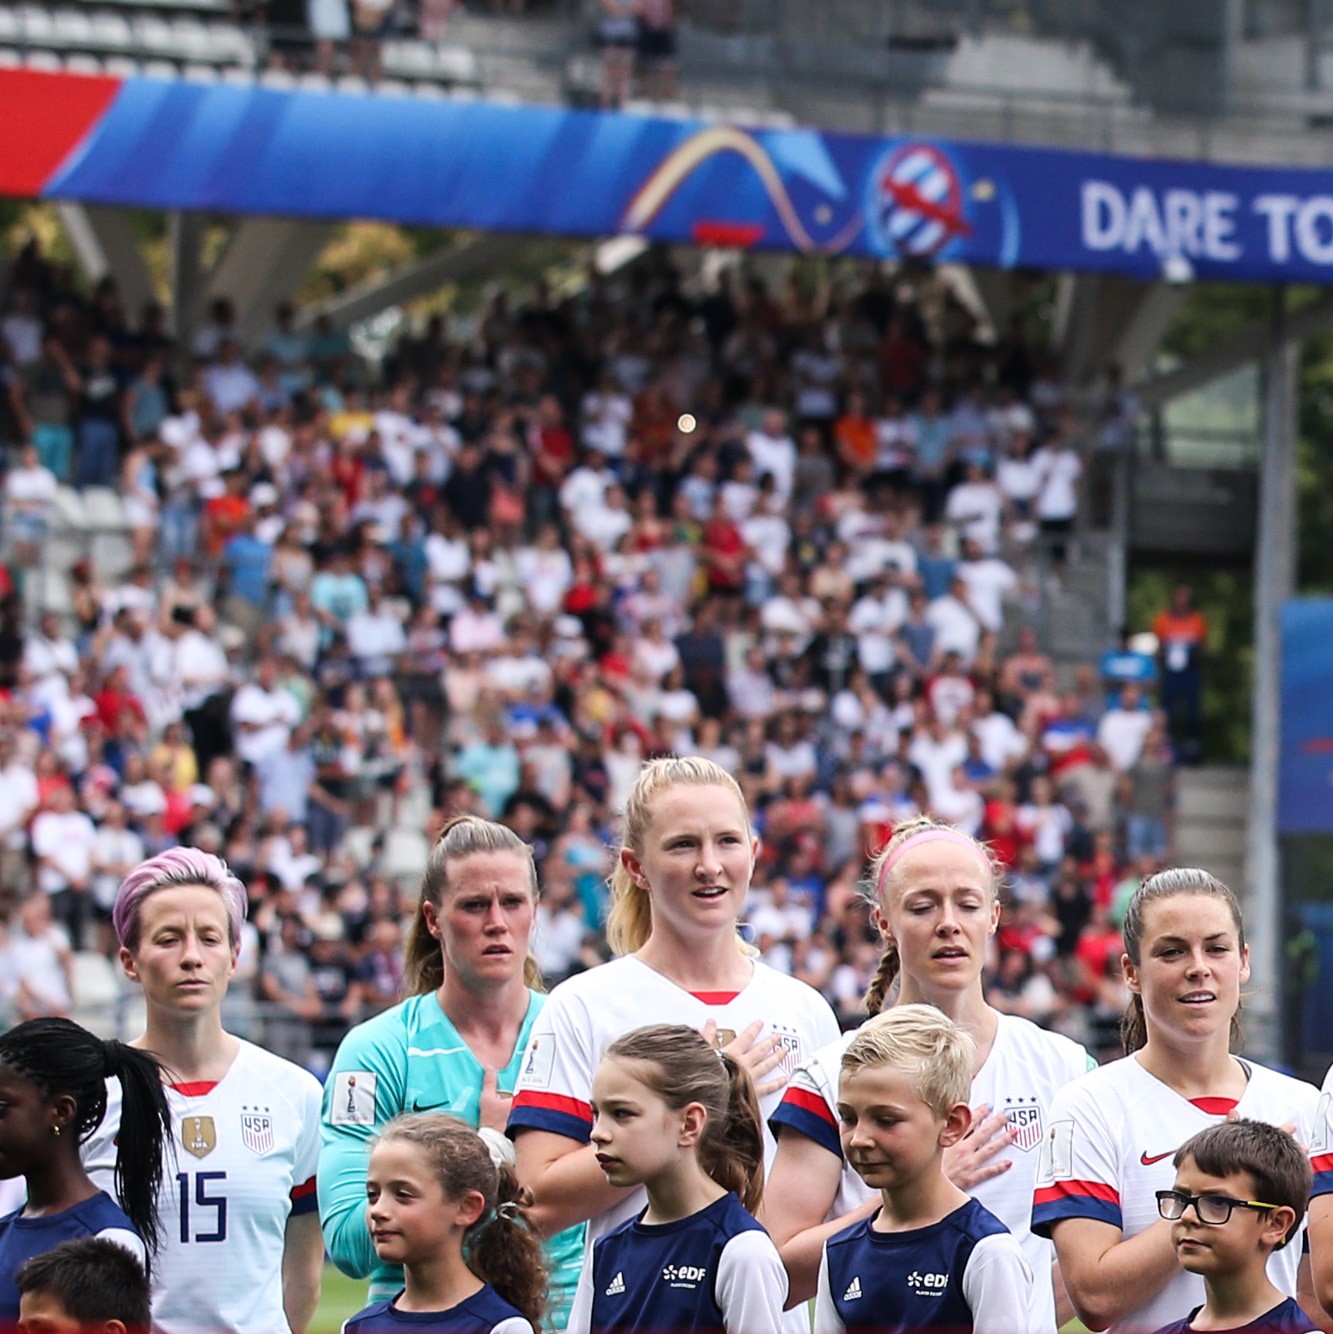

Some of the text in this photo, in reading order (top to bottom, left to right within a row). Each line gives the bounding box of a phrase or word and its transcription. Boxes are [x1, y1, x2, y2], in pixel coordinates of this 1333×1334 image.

[1081, 180, 1242, 262] DARE
[244, 1116, 270, 1133] USA
[176, 1170, 227, 1243] 15
